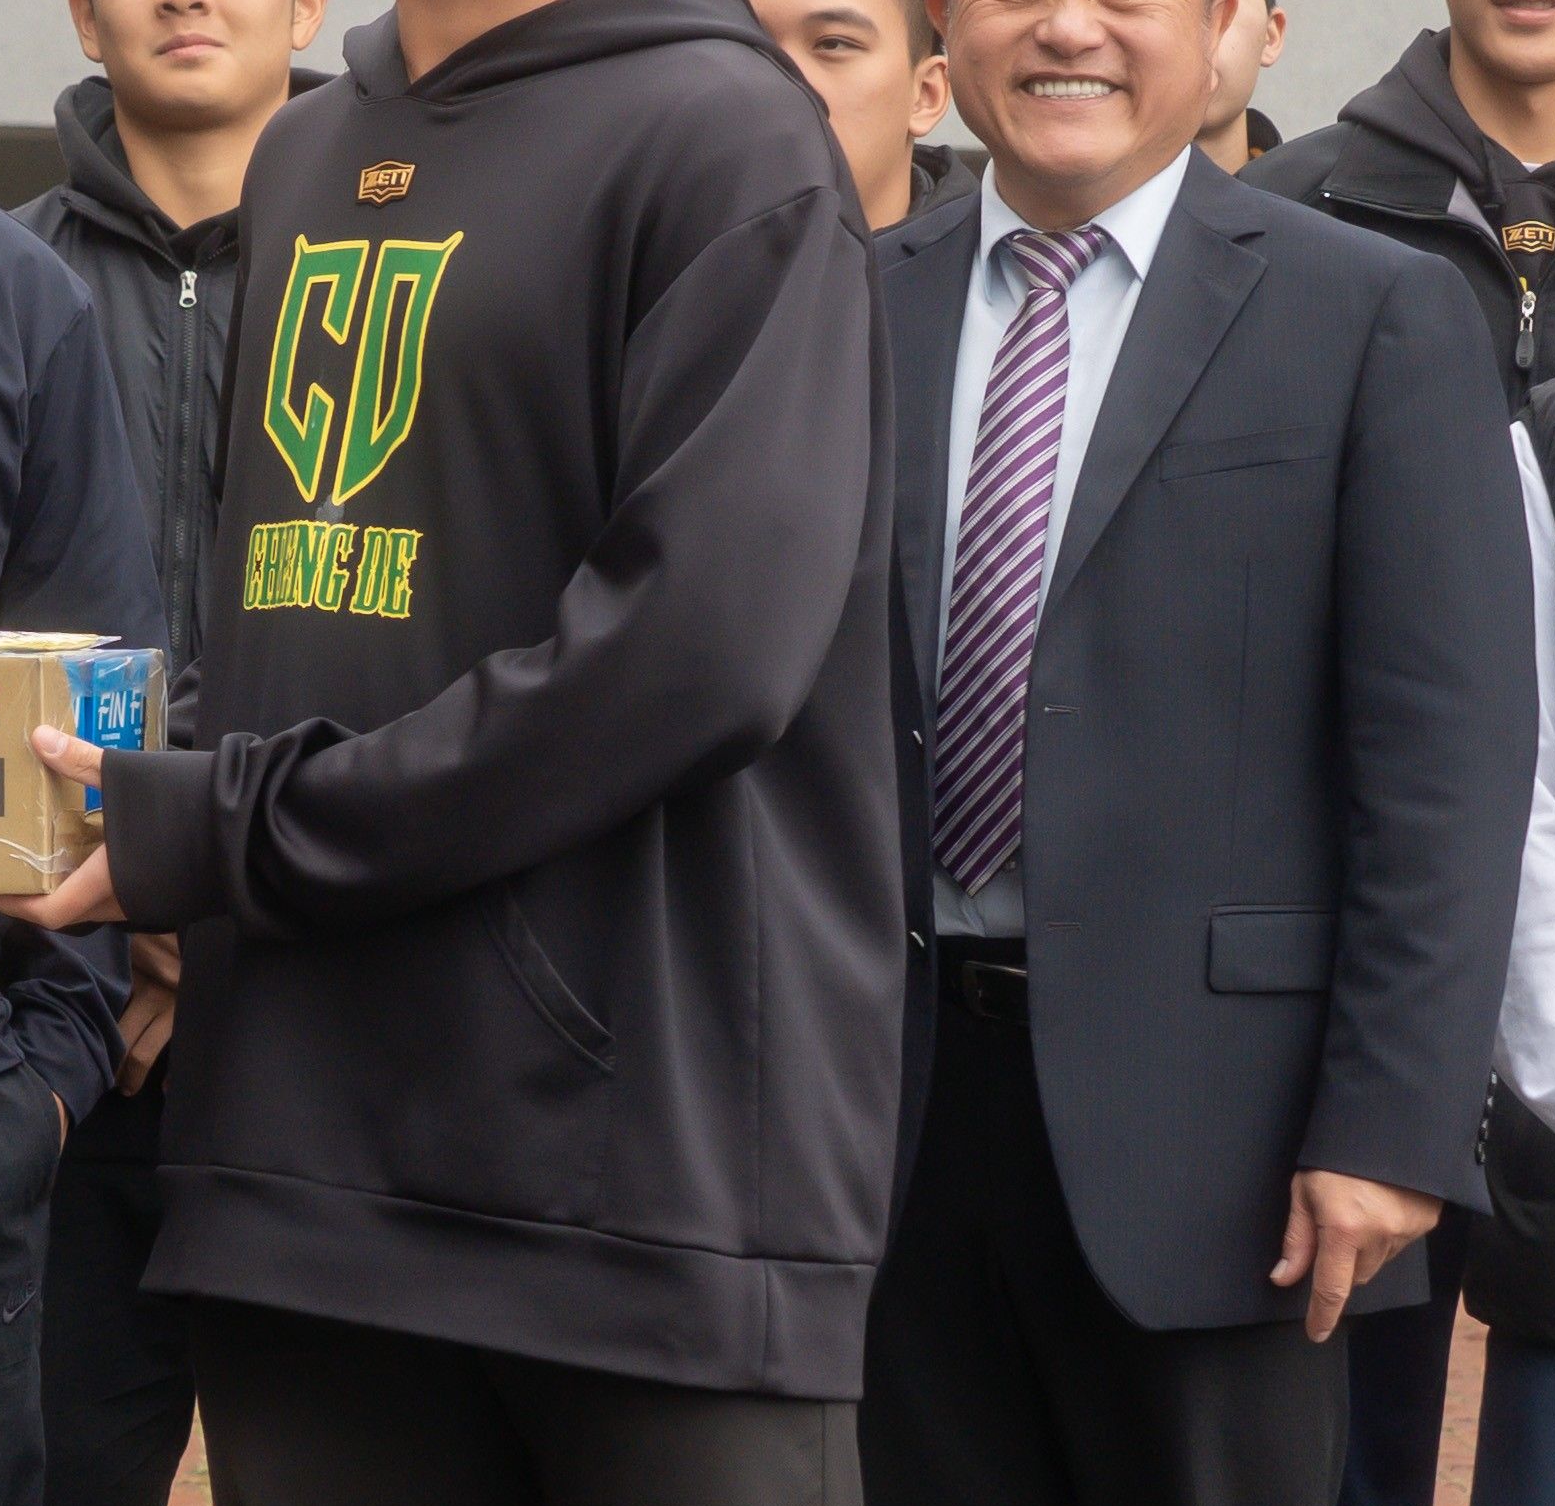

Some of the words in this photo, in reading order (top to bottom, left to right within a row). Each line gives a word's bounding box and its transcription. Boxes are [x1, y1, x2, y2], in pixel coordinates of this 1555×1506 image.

[364, 168, 411, 189] ZETT
[1508, 226, 1555, 242] ZETT
[348, 525, 424, 620] DE
[98, 691, 127, 730] FIN
